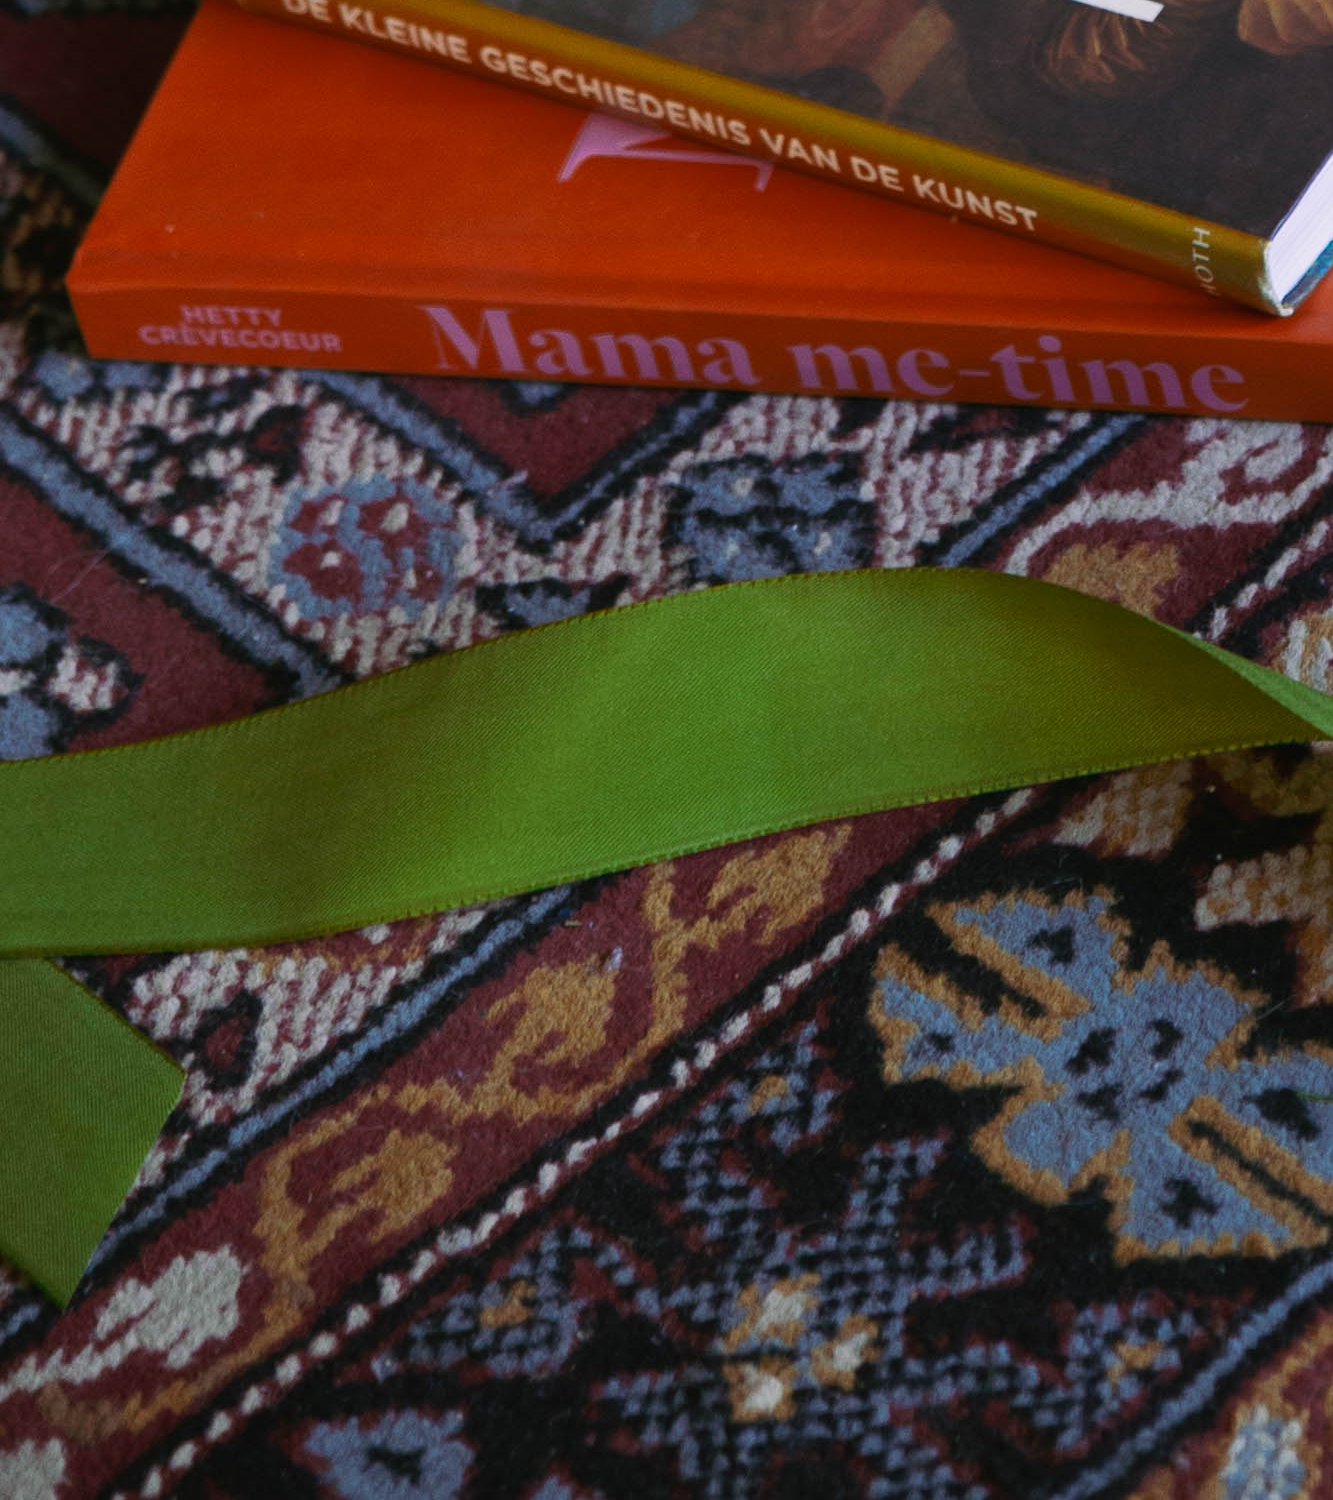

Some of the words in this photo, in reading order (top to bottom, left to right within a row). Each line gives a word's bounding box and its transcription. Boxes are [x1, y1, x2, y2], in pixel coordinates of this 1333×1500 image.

[338, 3, 472, 63] KLEINE
[479, 46, 751, 146] GESCHIEDENIS
[759, 128, 841, 173] VAN
[850, 155, 904, 192] DE
[912, 174, 1037, 231] KUNST
[180, 304, 282, 327] HETTY
[417, 304, 762, 386] Mama
[787, 334, 1249, 413] me-time
